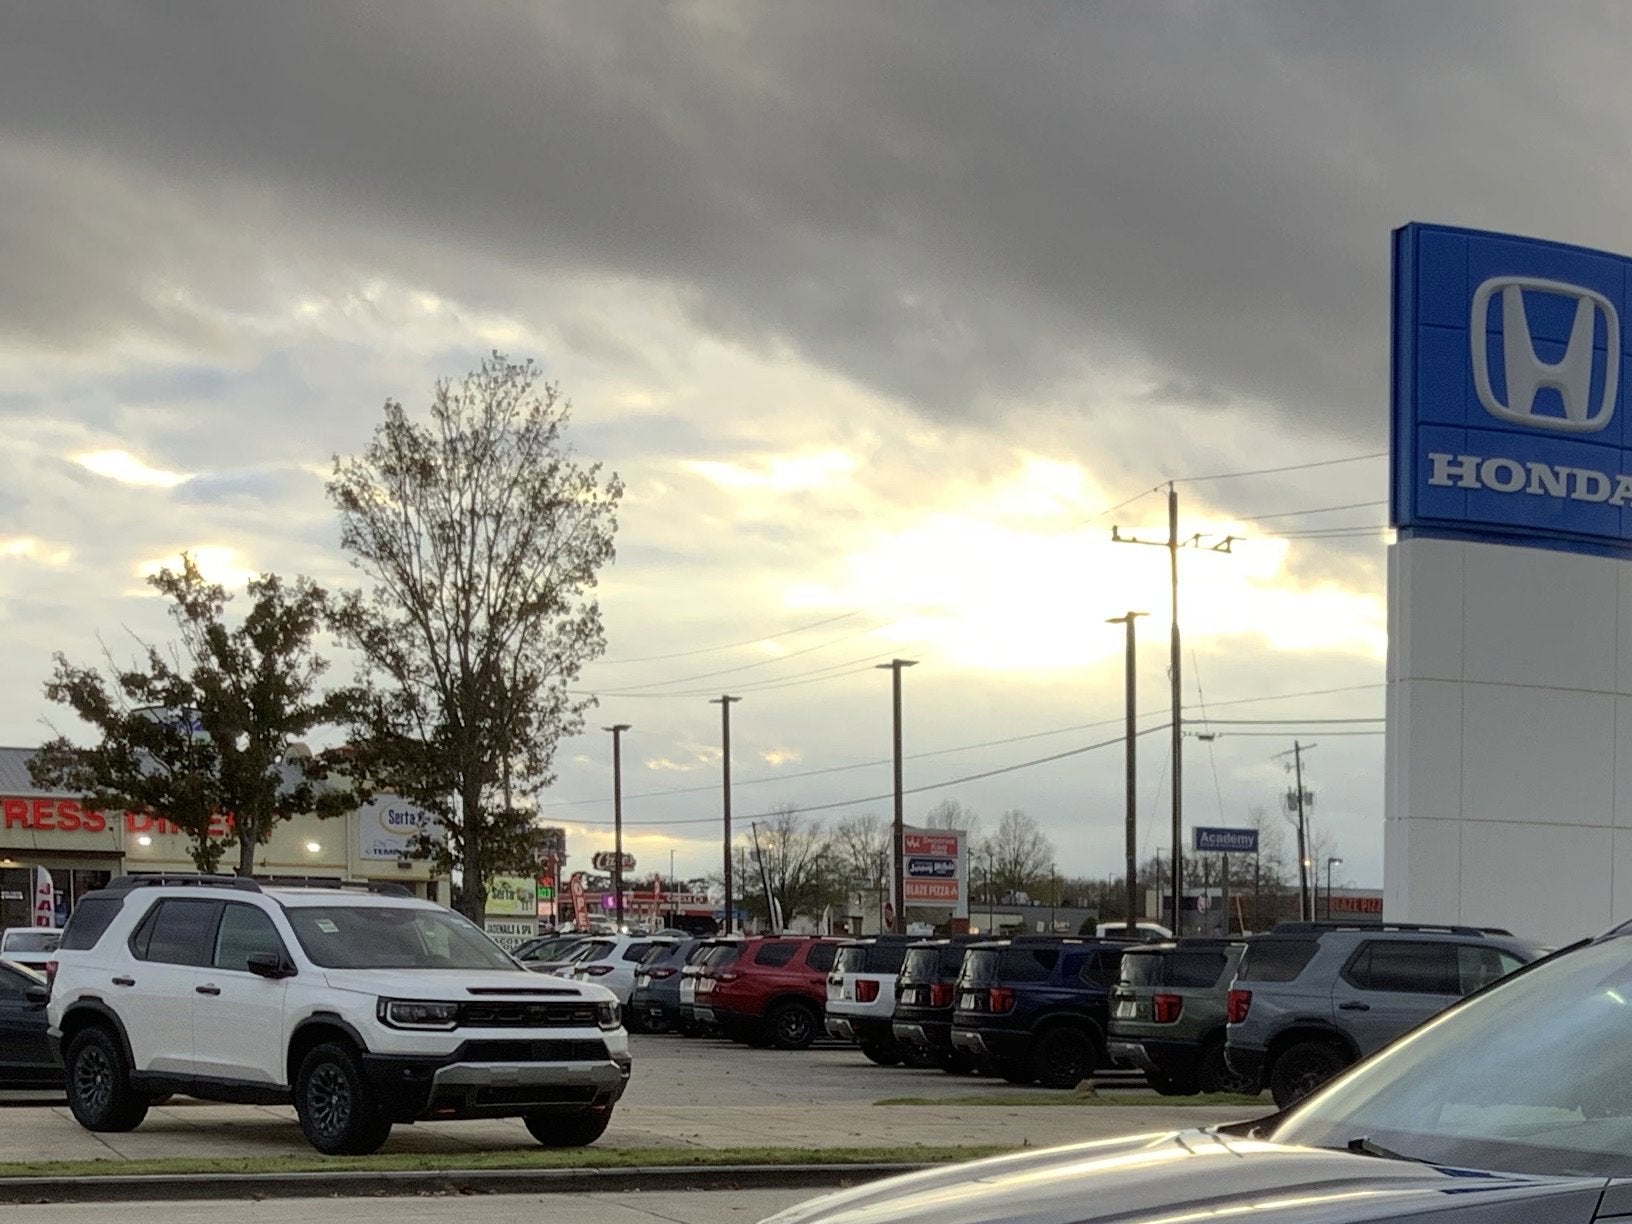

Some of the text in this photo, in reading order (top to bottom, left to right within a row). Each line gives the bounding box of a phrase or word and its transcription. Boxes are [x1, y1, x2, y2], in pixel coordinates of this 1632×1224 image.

[1, 799, 106, 832] RESS
[388, 808, 415, 825] Serta
[1200, 831, 1255, 848] Academy
[929, 884, 949, 897] PIZZA
